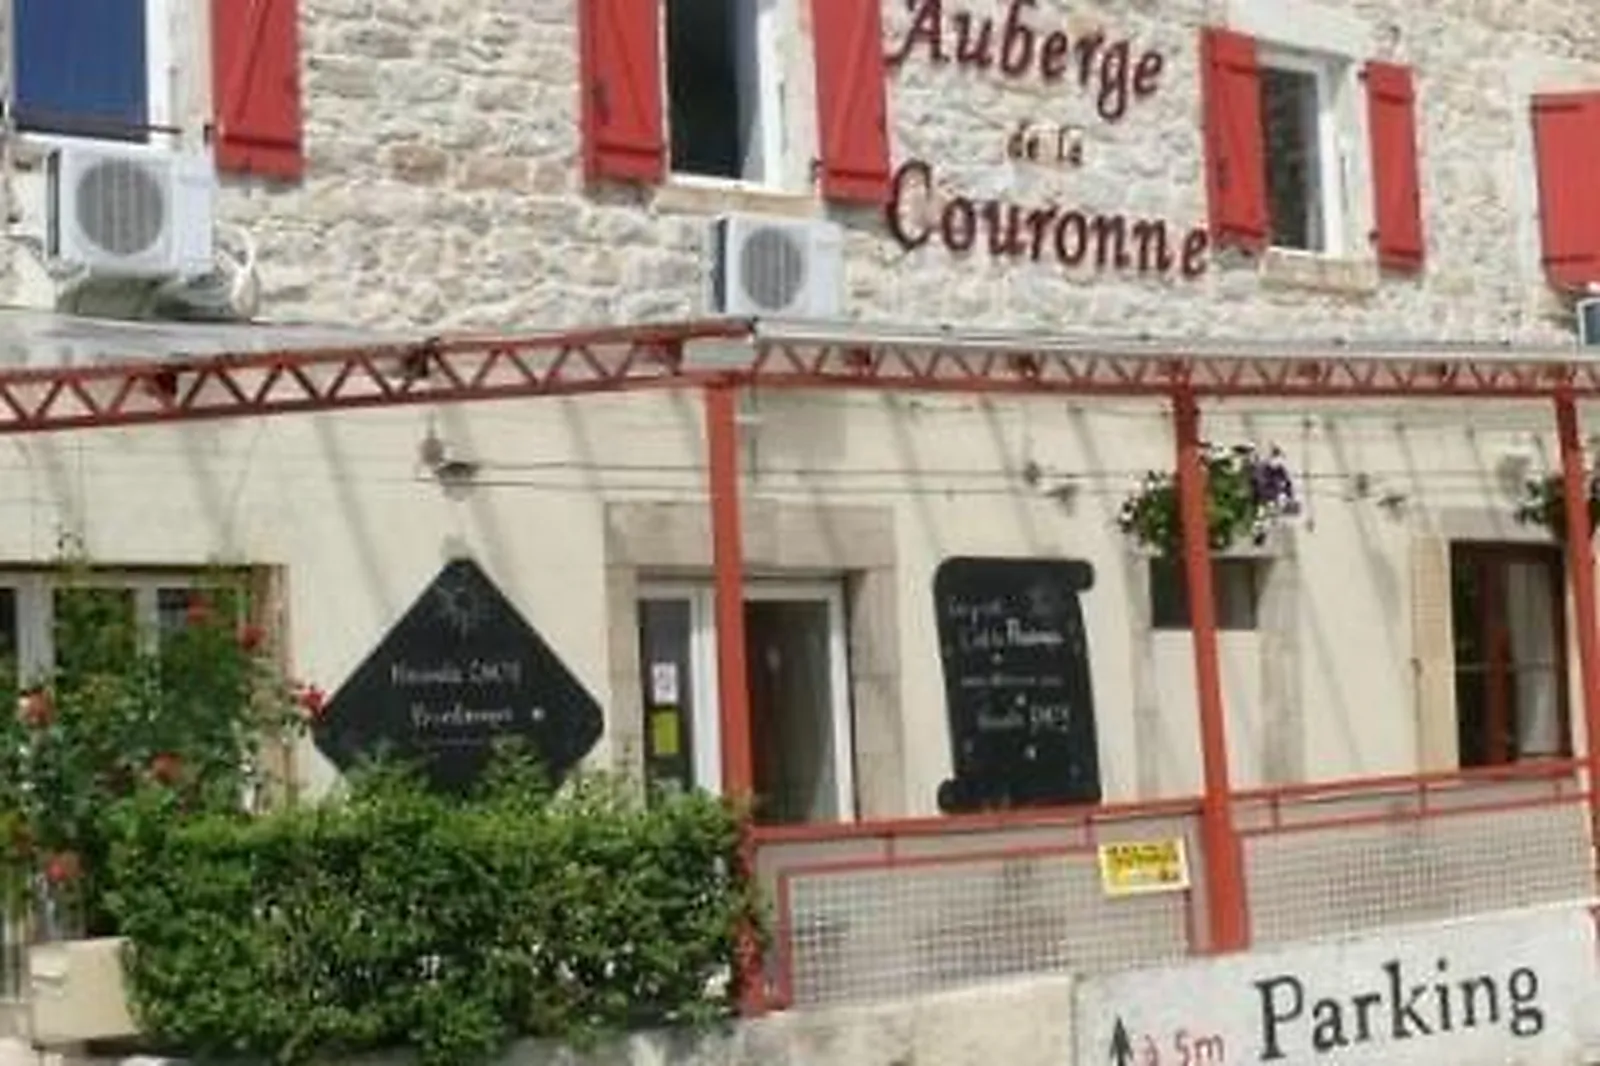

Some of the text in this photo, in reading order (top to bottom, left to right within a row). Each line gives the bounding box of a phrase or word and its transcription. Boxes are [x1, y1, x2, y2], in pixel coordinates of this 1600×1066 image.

[884, 0, 1163, 122] Auberge
[1007, 118, 1040, 161] de
[886, 159, 1208, 277] Couronne
[1174, 1029, 1224, 1066] 5m
[1254, 957, 1545, 1061] Parking
